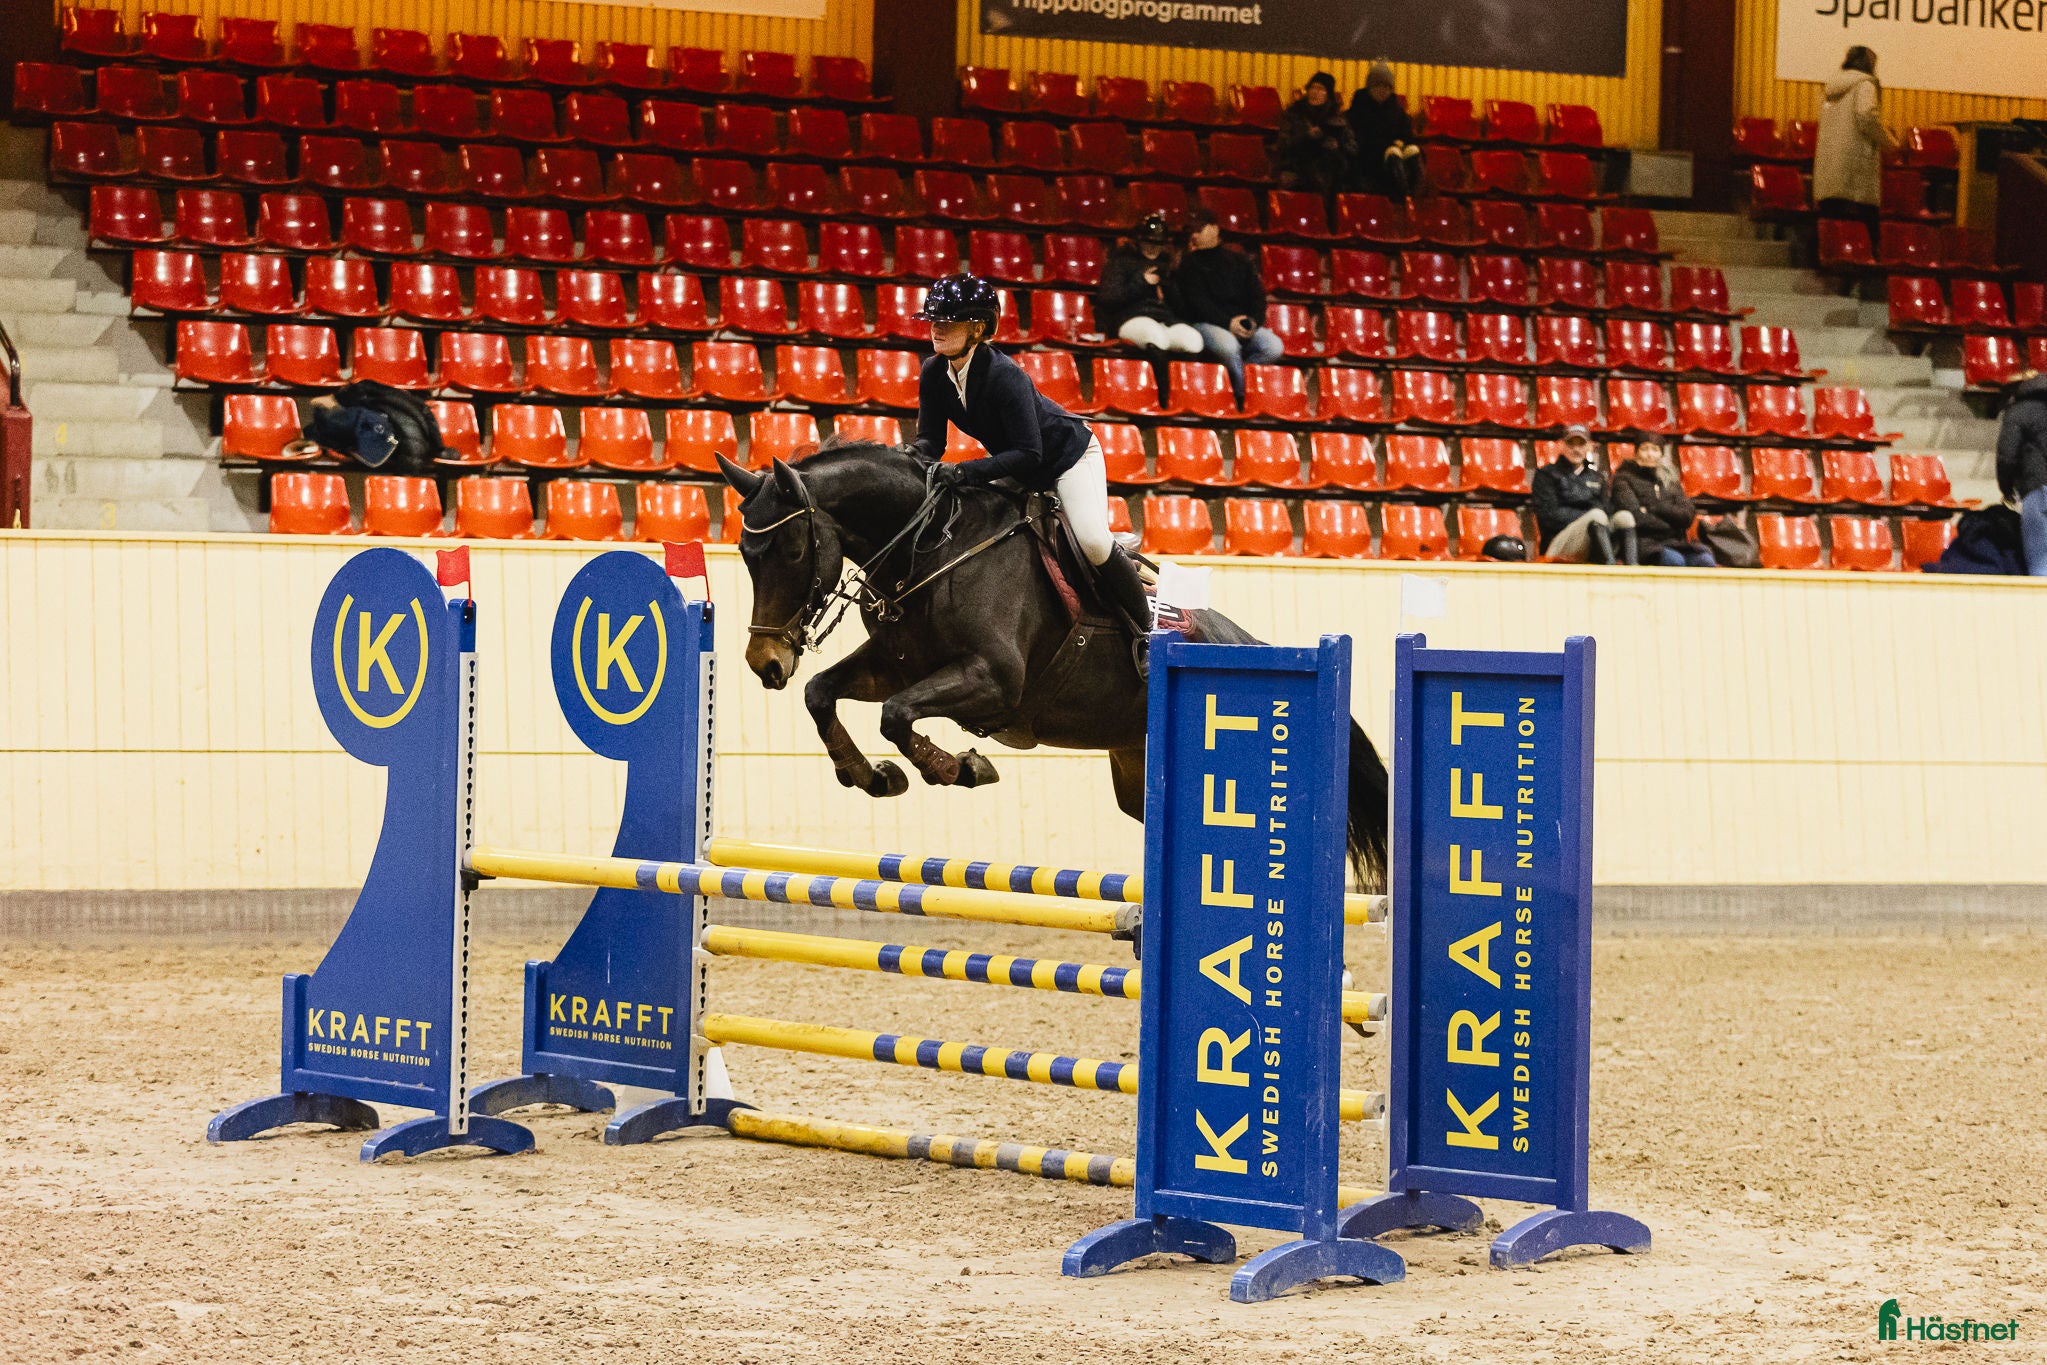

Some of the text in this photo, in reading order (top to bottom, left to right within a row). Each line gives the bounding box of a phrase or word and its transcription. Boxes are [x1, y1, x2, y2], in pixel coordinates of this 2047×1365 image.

[357, 611, 406, 695] K
[596, 613, 645, 693] K
[1195, 694, 1259, 1175] KRAFFT
[1261, 701, 1289, 1178] SWEDISH HORSE NUTRITION
[1446, 691, 1505, 1151] KRAFFT
[1512, 697, 1535, 1153] SWEDISH HORSE NUTRITION
[308, 1008, 432, 1050] KRAFFT
[308, 1043, 431, 1067] SWEDISH HORSE NUTRITION
[549, 1026, 672, 1050] SWEDISH HORSE NUTRITION
[550, 993, 674, 1035] KRAFFT
